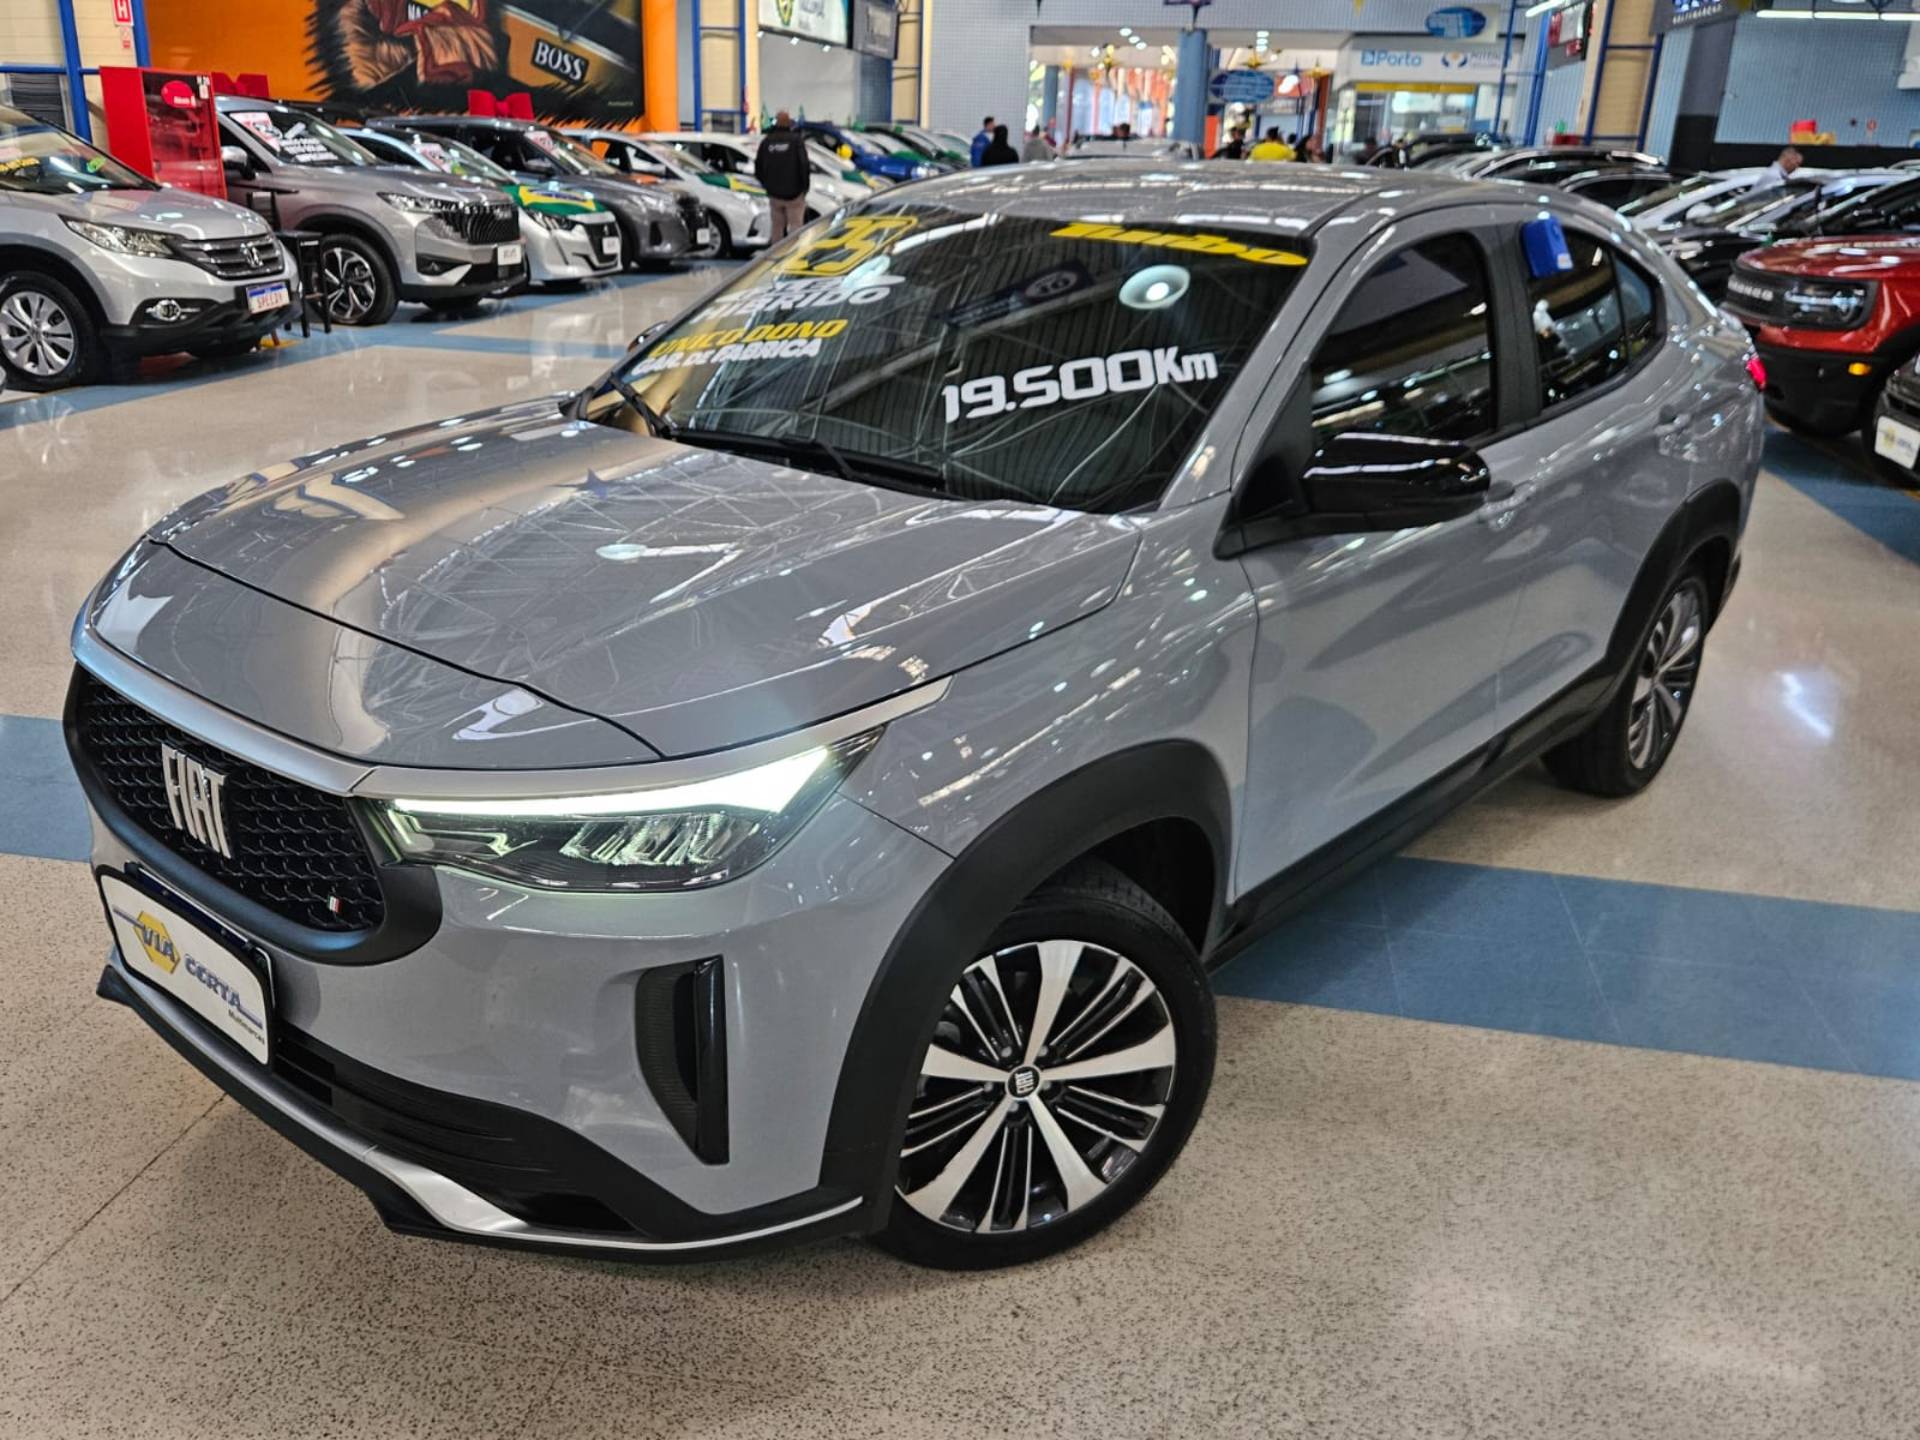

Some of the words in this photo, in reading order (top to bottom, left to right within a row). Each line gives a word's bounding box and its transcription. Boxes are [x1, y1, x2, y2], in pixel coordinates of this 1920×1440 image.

[534, 41, 585, 82] BOSS
[1376, 51, 1422, 66] Porto
[748, 319, 849, 341] DONO
[710, 338, 822, 364] FABRICA
[161, 743, 232, 859] FIAT
[143, 924, 177, 963] VIA
[185, 953, 242, 1010] CERTA
